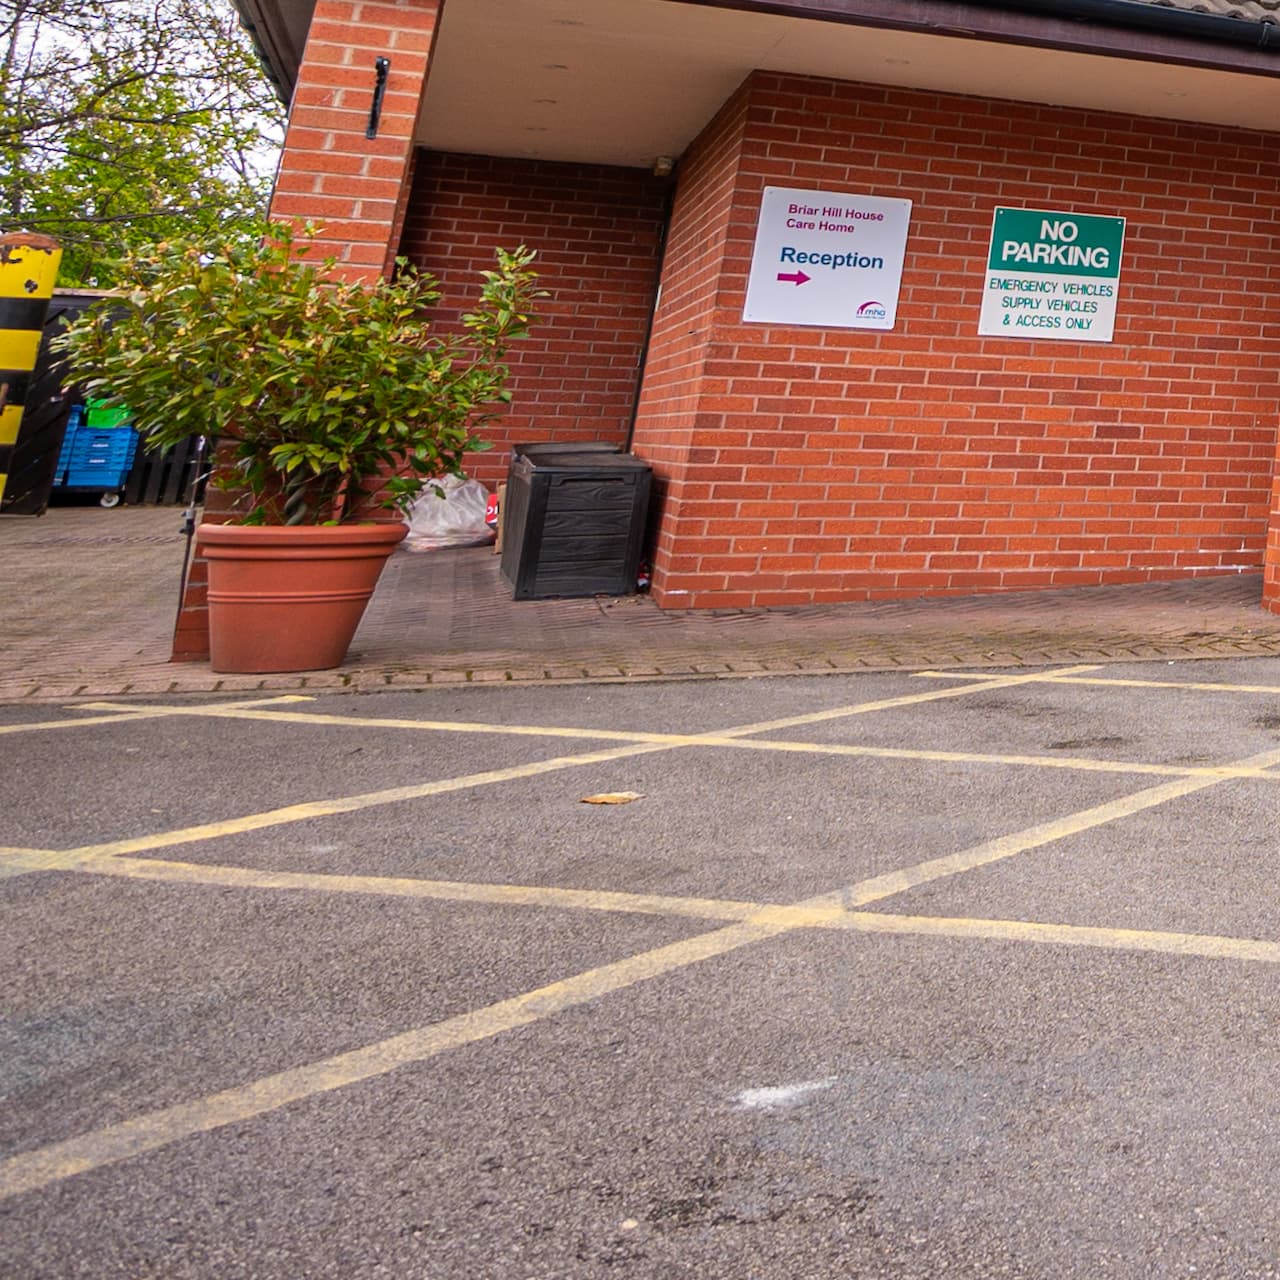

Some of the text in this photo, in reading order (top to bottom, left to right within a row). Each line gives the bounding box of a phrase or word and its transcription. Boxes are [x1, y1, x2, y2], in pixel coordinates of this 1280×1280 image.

[788, 203, 884, 221] Briar Hill House
[786, 218, 854, 233] Care Home
[1040, 220, 1078, 242] NO
[780, 246, 884, 270] Reception
[1002, 240, 1110, 269] PARKING
[989, 277, 1113, 297] EMERGENCY VEHICLES
[1001, 296, 1098, 313] SUPPLY VEHICLES
[1002, 314, 1092, 329] & ACCESS ONLY
